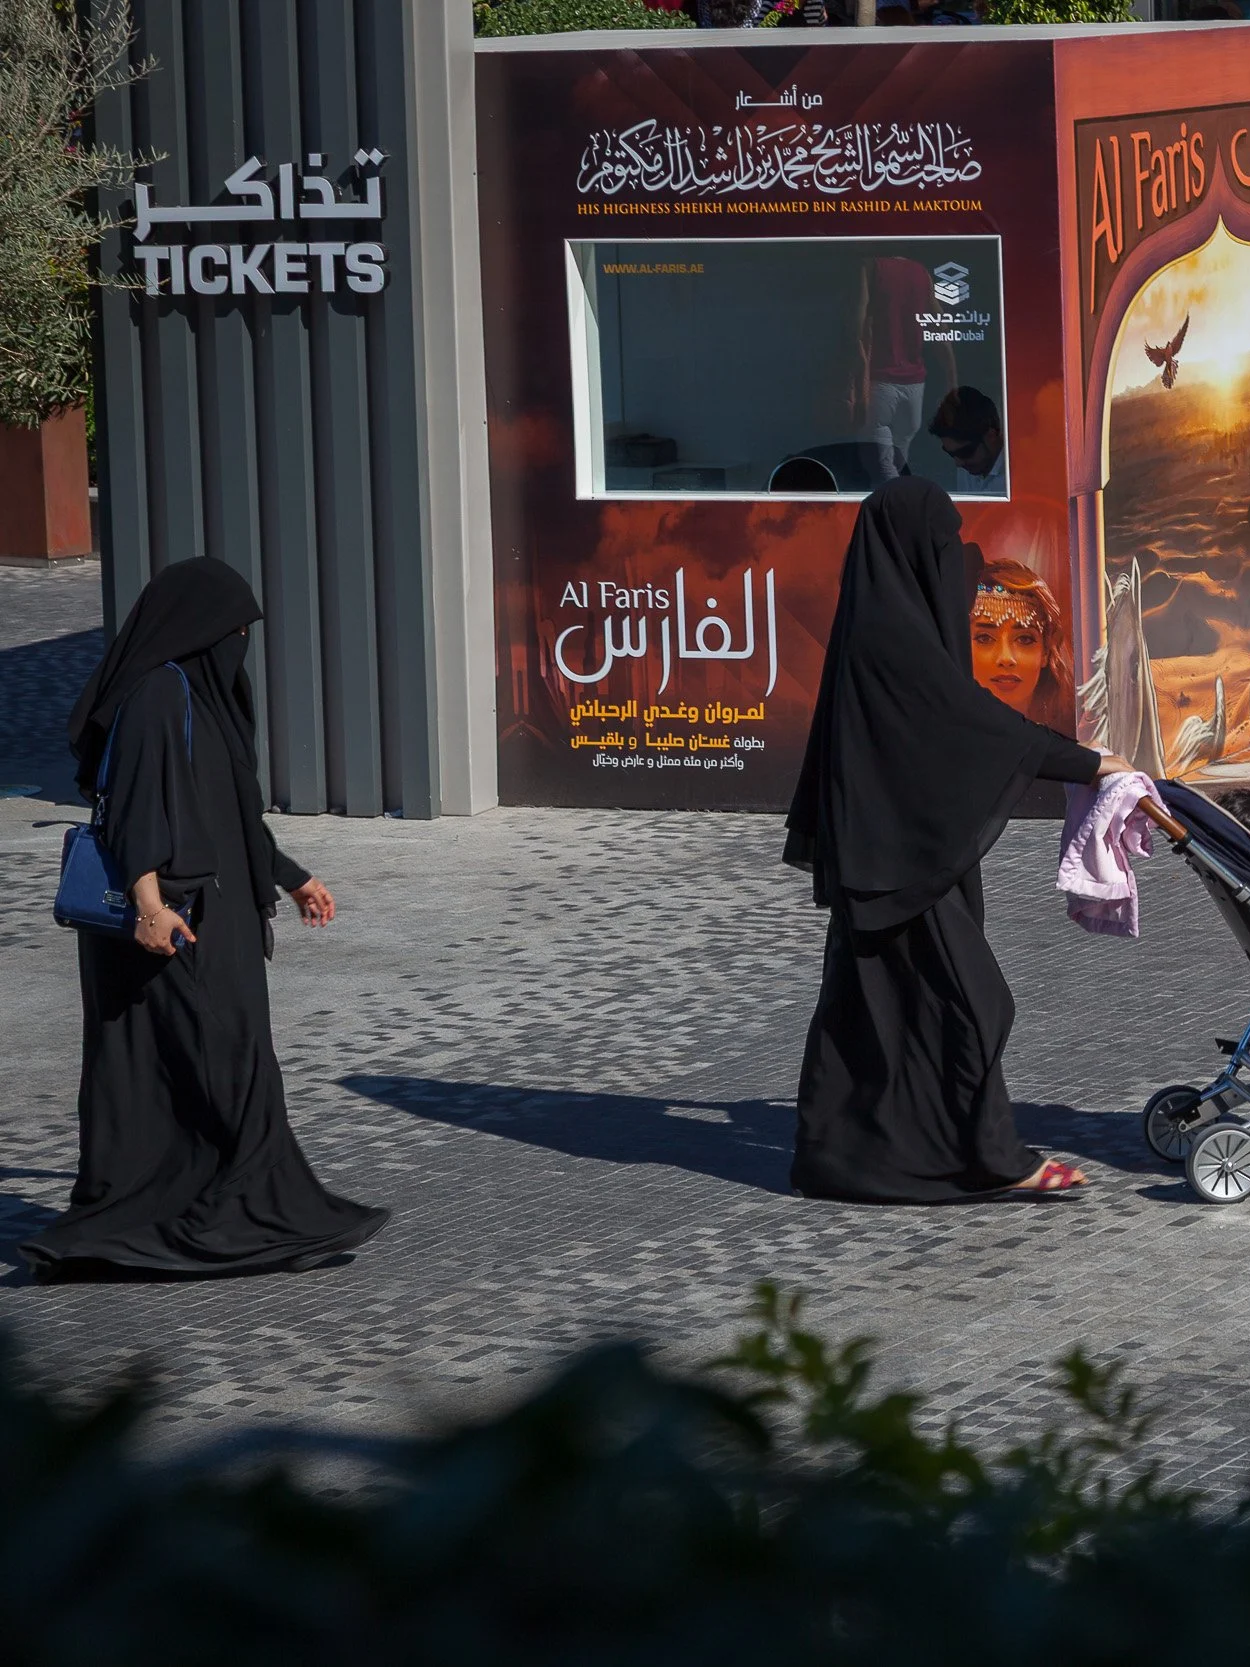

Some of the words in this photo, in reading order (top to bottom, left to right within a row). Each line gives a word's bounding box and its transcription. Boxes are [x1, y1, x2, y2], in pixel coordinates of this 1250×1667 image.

[802, 92, 822, 109] من
[132, 147, 386, 242] تذاكر
[577, 203, 600, 215] HIS
[603, 203, 671, 215] HIGHNESS
[674, 202, 723, 214] SHEIKH
[726, 201, 809, 213] MOHAMMED
[813, 201, 836, 212] BIN
[841, 200, 891, 212] RASHID
[894, 200, 910, 212] AL
[913, 200, 982, 211] MAKTOUM
[1090, 136, 1123, 314] Al
[1130, 122, 1205, 230] Faris
[133, 242, 386, 295] TICKETS
[603, 264, 705, 274] WWW.AL-FARIS.AE
[559, 581, 588, 608] Al
[597, 581, 670, 609] Faris
[554, 566, 778, 697] الفارس
[570, 699, 638, 727] الرحباني
[628, 736, 638, 750] و
[733, 736, 765, 751] بطولة
[646, 757, 655, 769] و
[656, 755, 681, 769] ممثل
[703, 757, 718, 770] من
